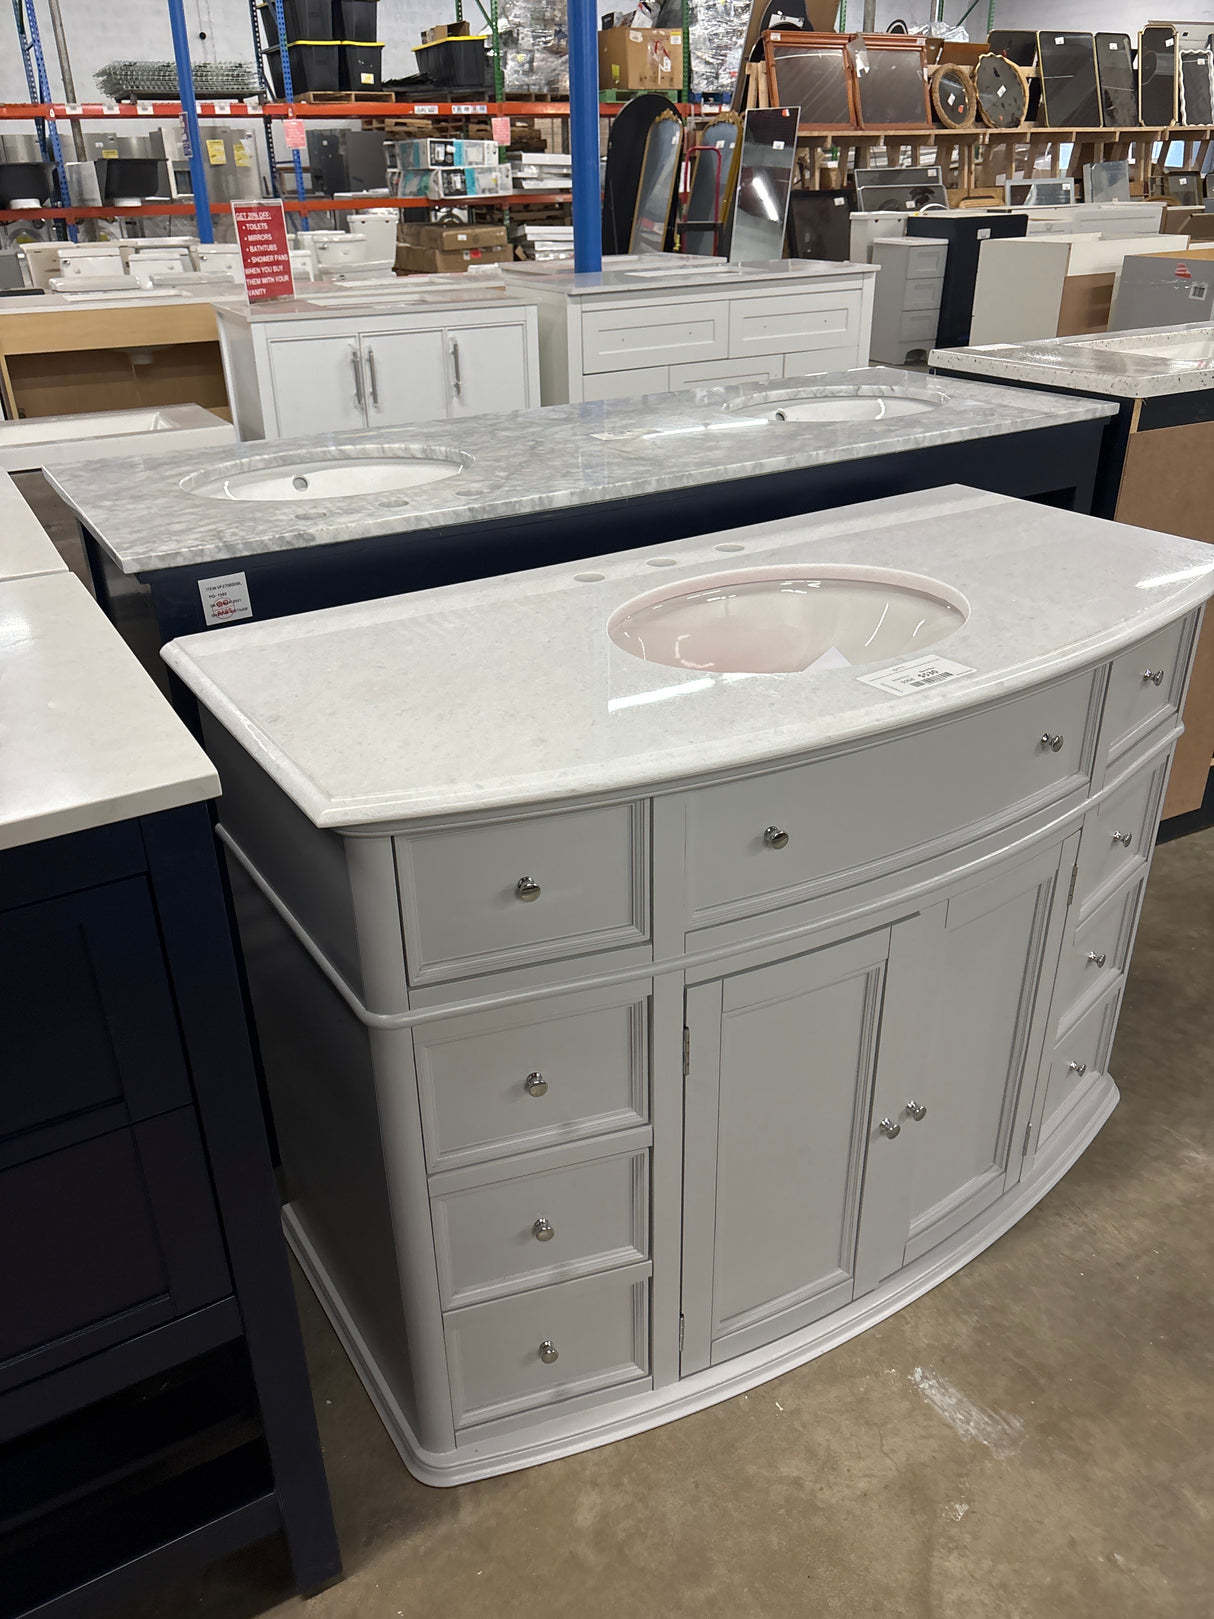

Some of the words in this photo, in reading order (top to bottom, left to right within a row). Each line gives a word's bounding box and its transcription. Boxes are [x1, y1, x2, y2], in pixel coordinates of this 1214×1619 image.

[235, 212, 246, 220] GET
[249, 244, 277, 252] BATHTUBS
[251, 255, 274, 263] SHOWER
[262, 277, 275, 285] WITH
[248, 288, 266, 296] VANITY
